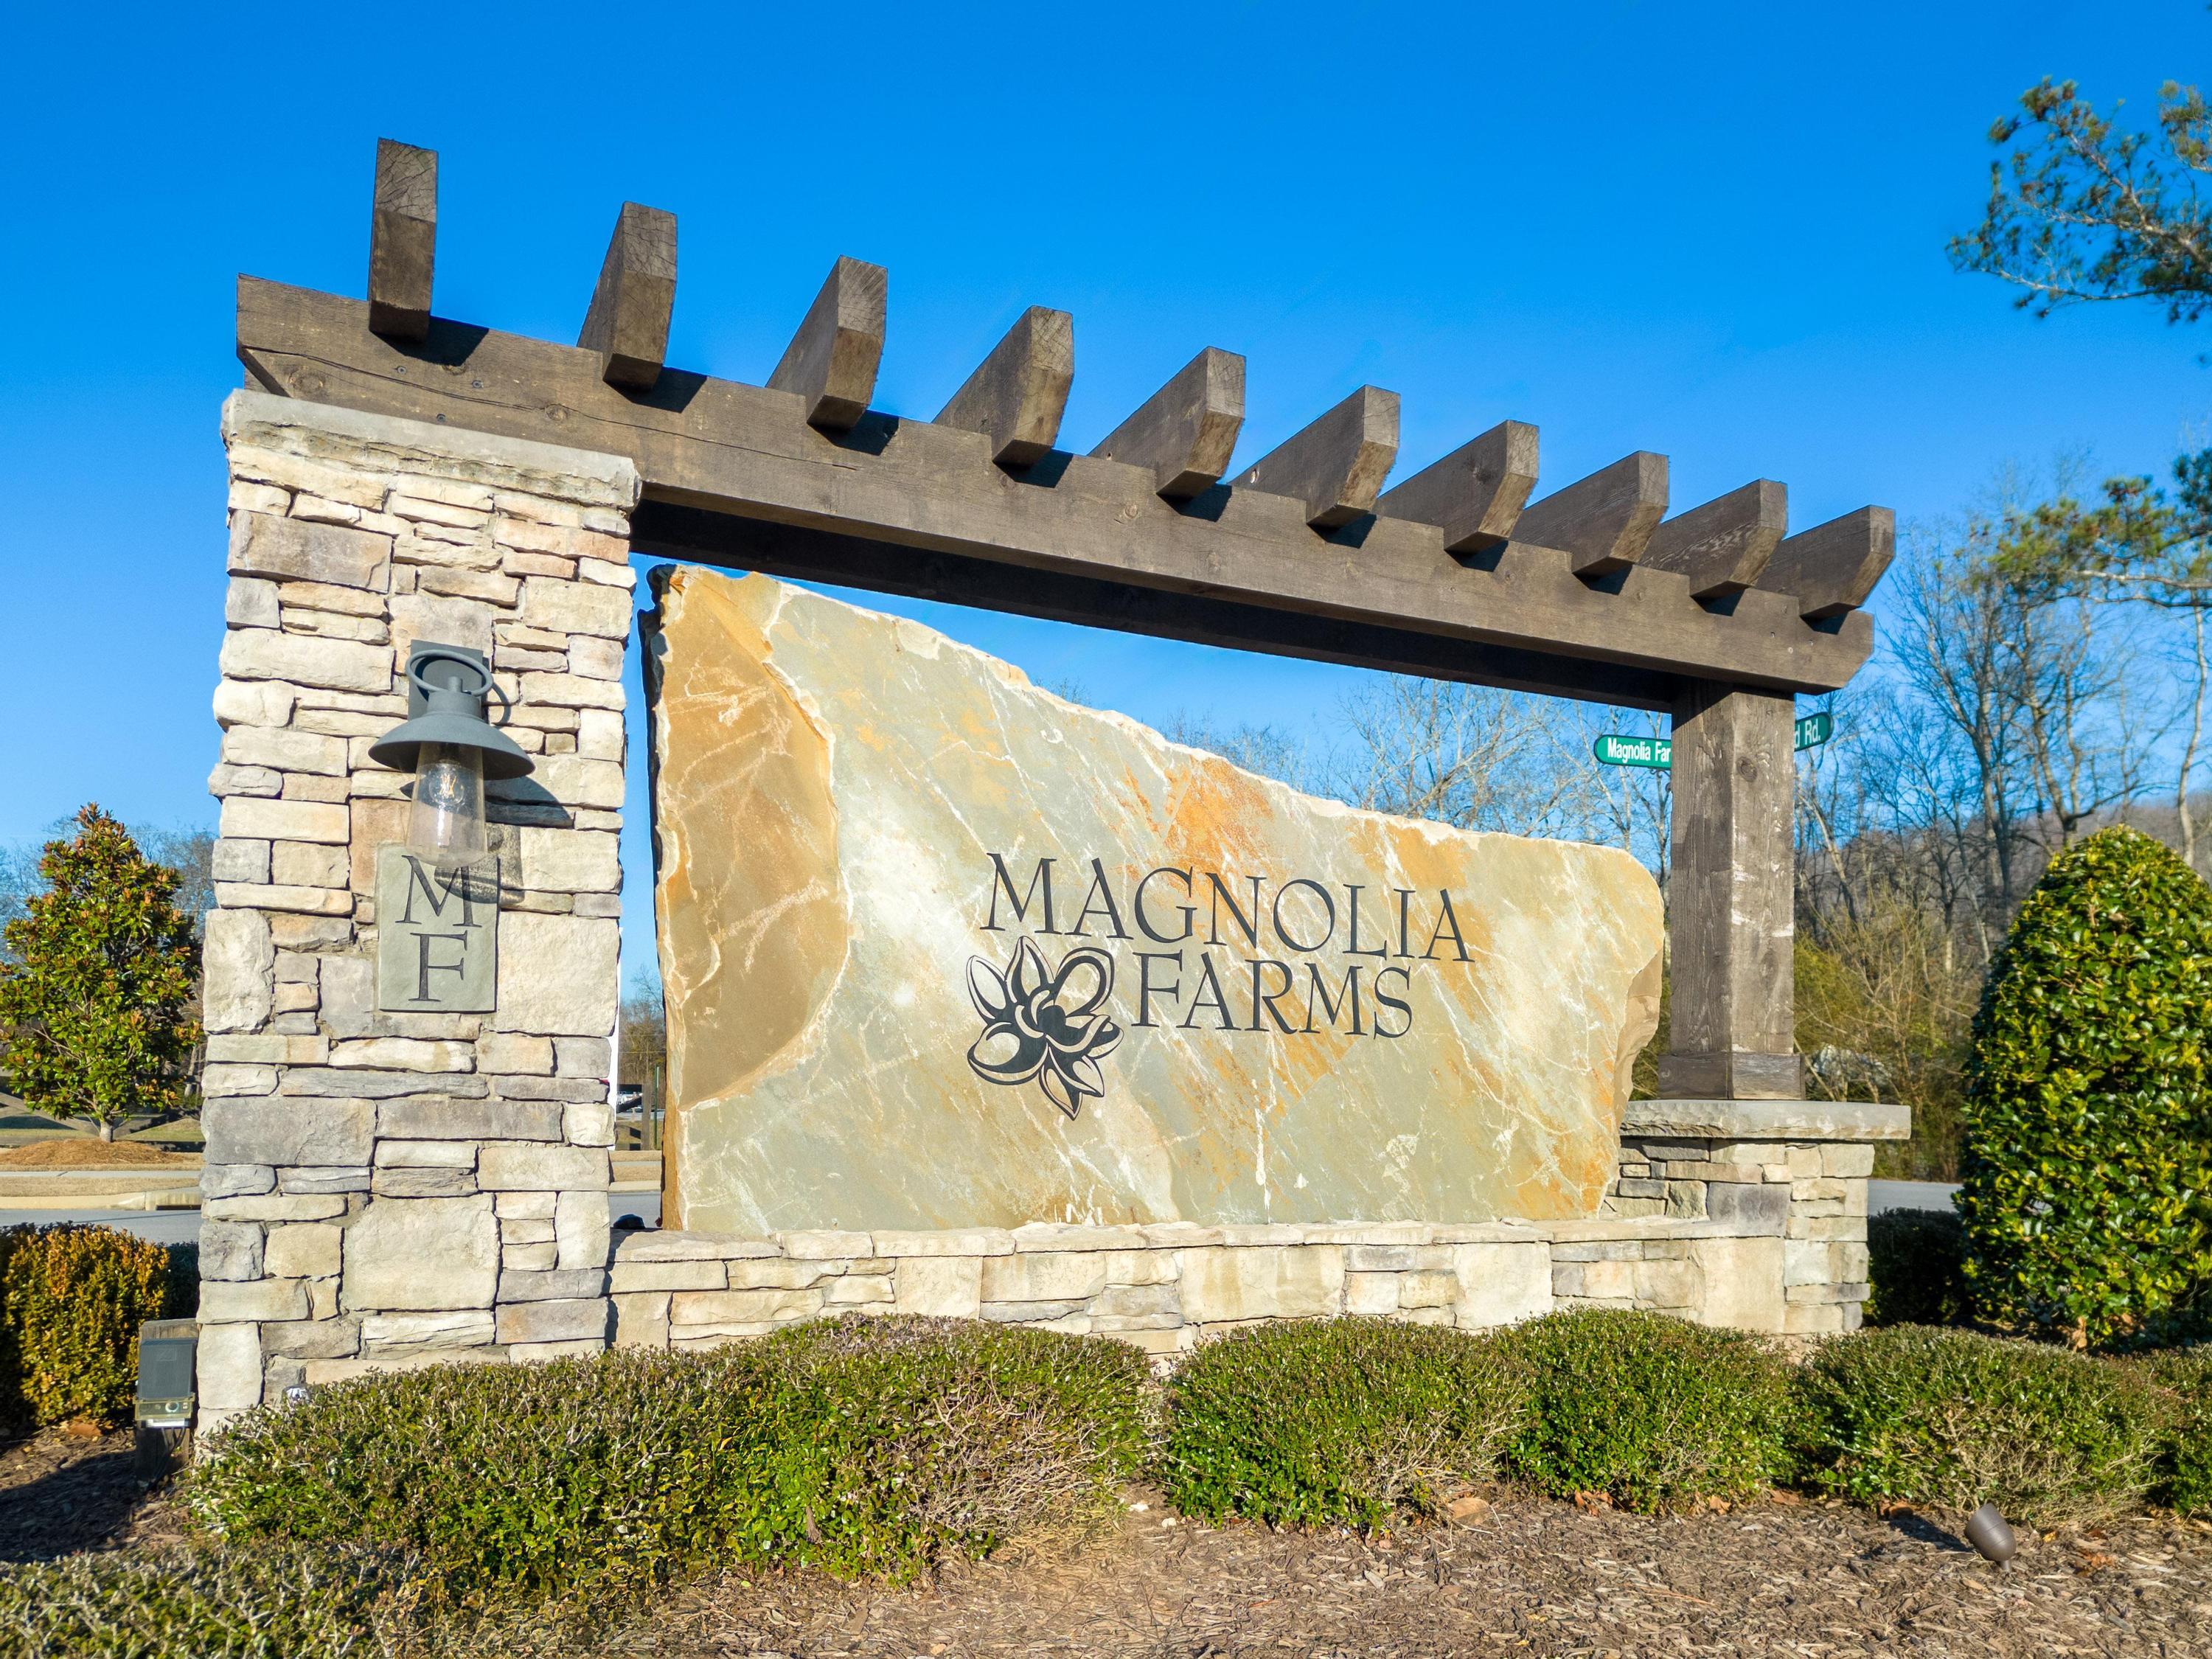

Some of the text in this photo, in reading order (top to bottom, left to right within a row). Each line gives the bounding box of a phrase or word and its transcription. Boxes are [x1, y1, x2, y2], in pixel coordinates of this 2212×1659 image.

[1607, 737, 1651, 764] Magnolia
[1804, 717, 1821, 745] Rd.
[395, 855, 482, 928] M
[979, 852, 1475, 962] MAGNOLIA
[408, 930, 467, 1002] F
[1131, 949, 1413, 1040] FARMS
